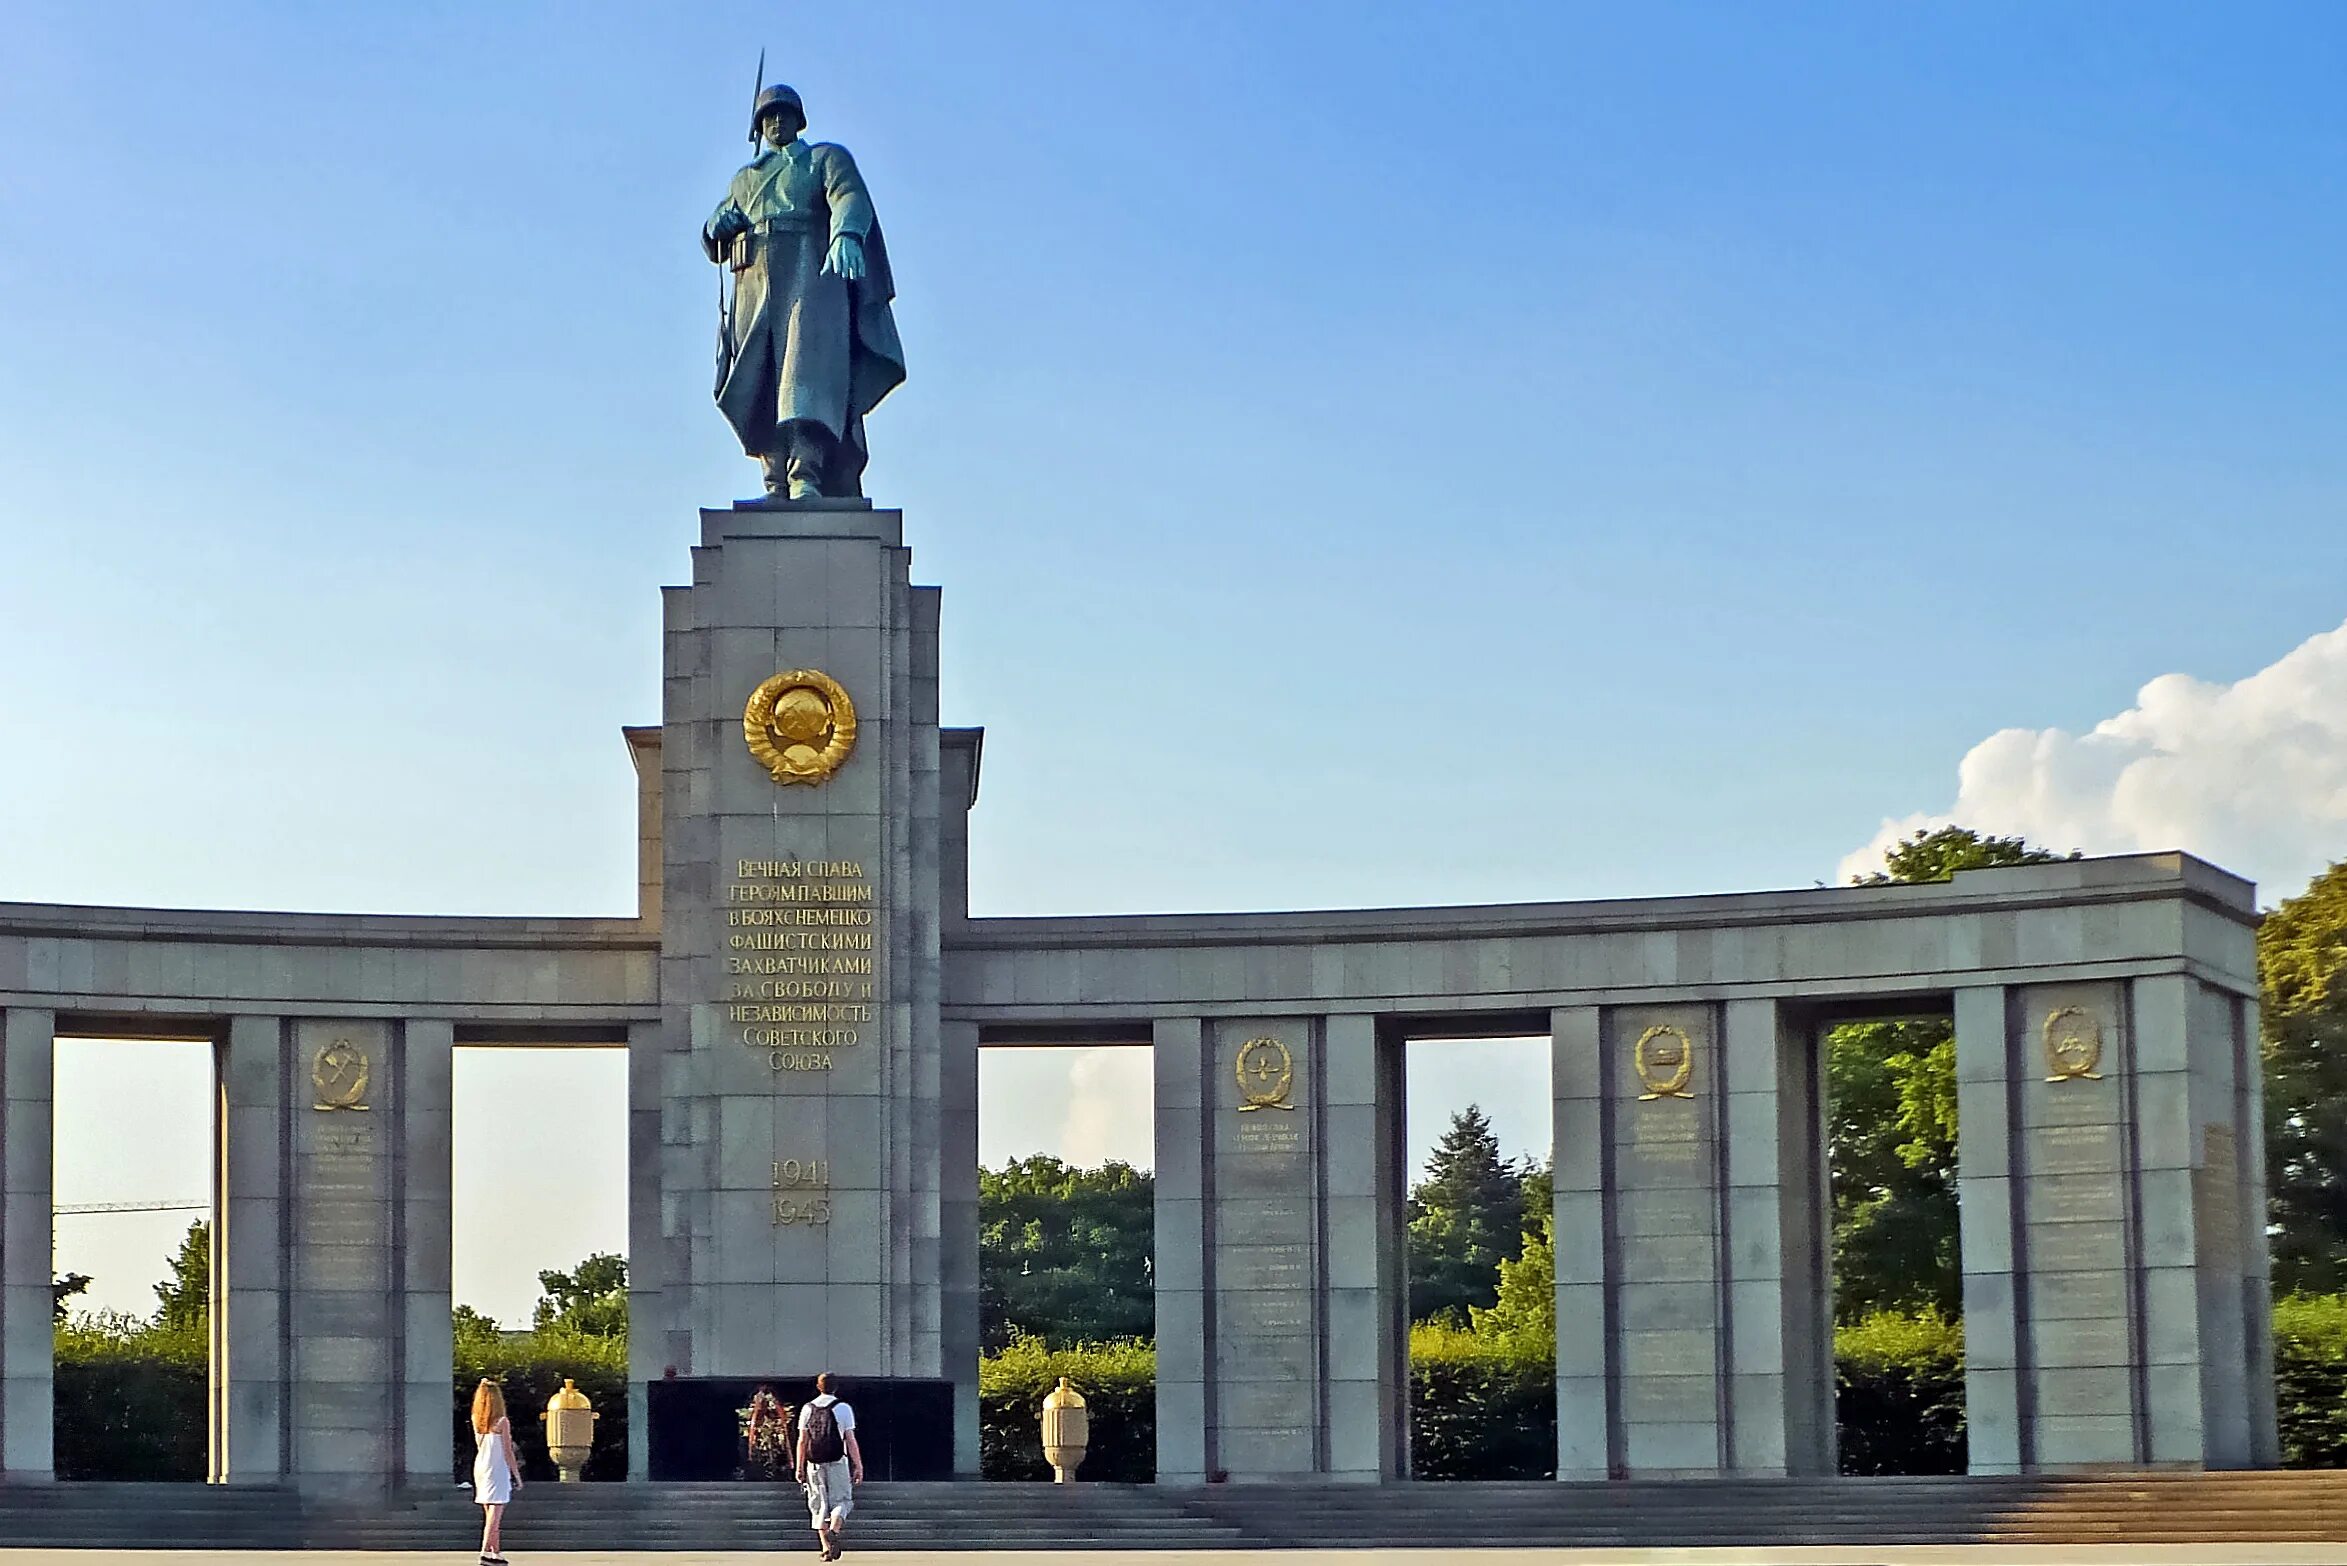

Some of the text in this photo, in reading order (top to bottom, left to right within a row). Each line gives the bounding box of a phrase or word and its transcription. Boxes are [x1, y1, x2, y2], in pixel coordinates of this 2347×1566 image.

[730, 885, 871, 901] ГЕРОЯМ ПАВШИМ
[730, 911, 739, 926] В
[742, 909, 783, 926] БОЯХ
[729, 933, 871, 950] ФАШИСТСКИМИ
[730, 957, 871, 975] ЗАХВАТЧИКАМИ
[733, 982, 754, 998] ЗА
[730, 1005, 872, 1022] НЕЗАВИСИМОСТЬ
[743, 1026, 857, 1046] СОВЕТСКОГО
[768, 1051, 833, 1071] СОЮЗА
[772, 1159, 828, 1186] 1941
[770, 1199, 830, 1226] 1945
